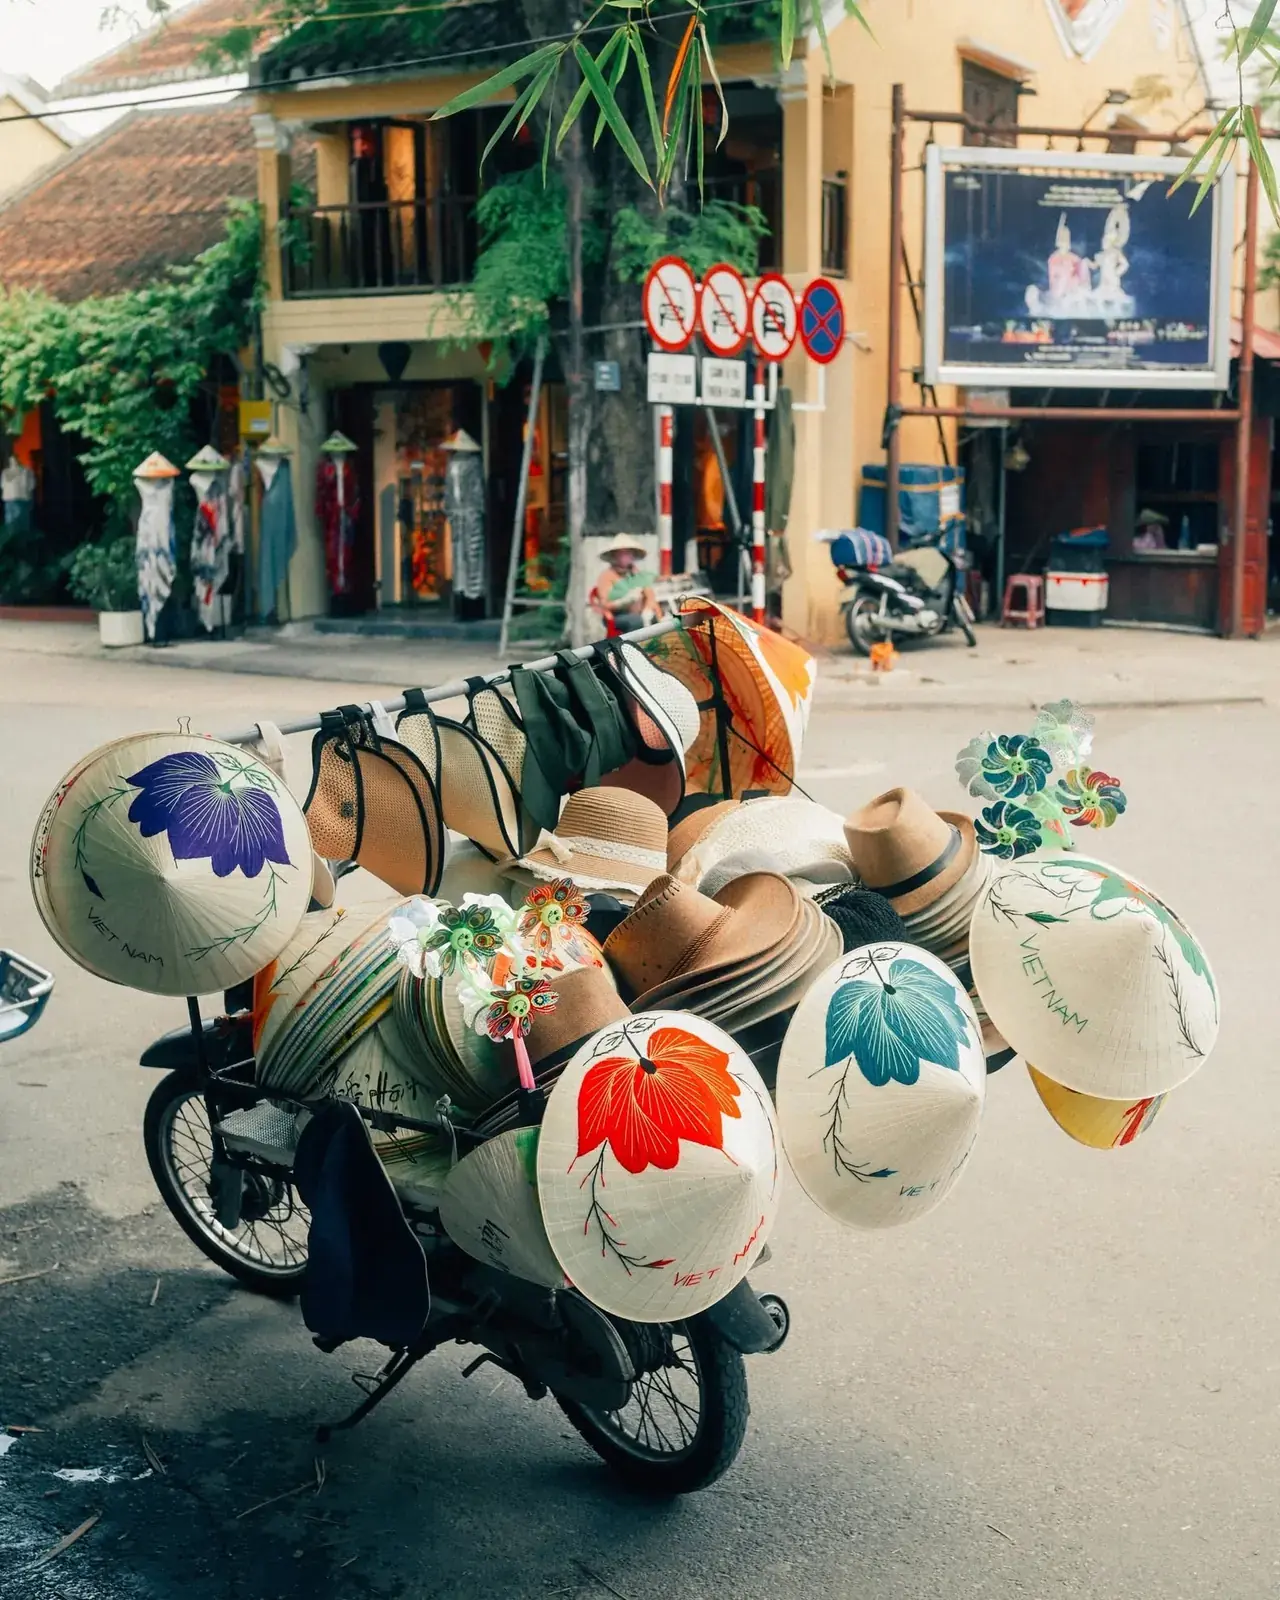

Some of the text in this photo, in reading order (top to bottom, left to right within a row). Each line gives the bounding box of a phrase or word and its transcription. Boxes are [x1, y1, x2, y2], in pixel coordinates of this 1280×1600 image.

[87, 906, 164, 968] VIET NAM
[673, 1267, 721, 1287] VIET
